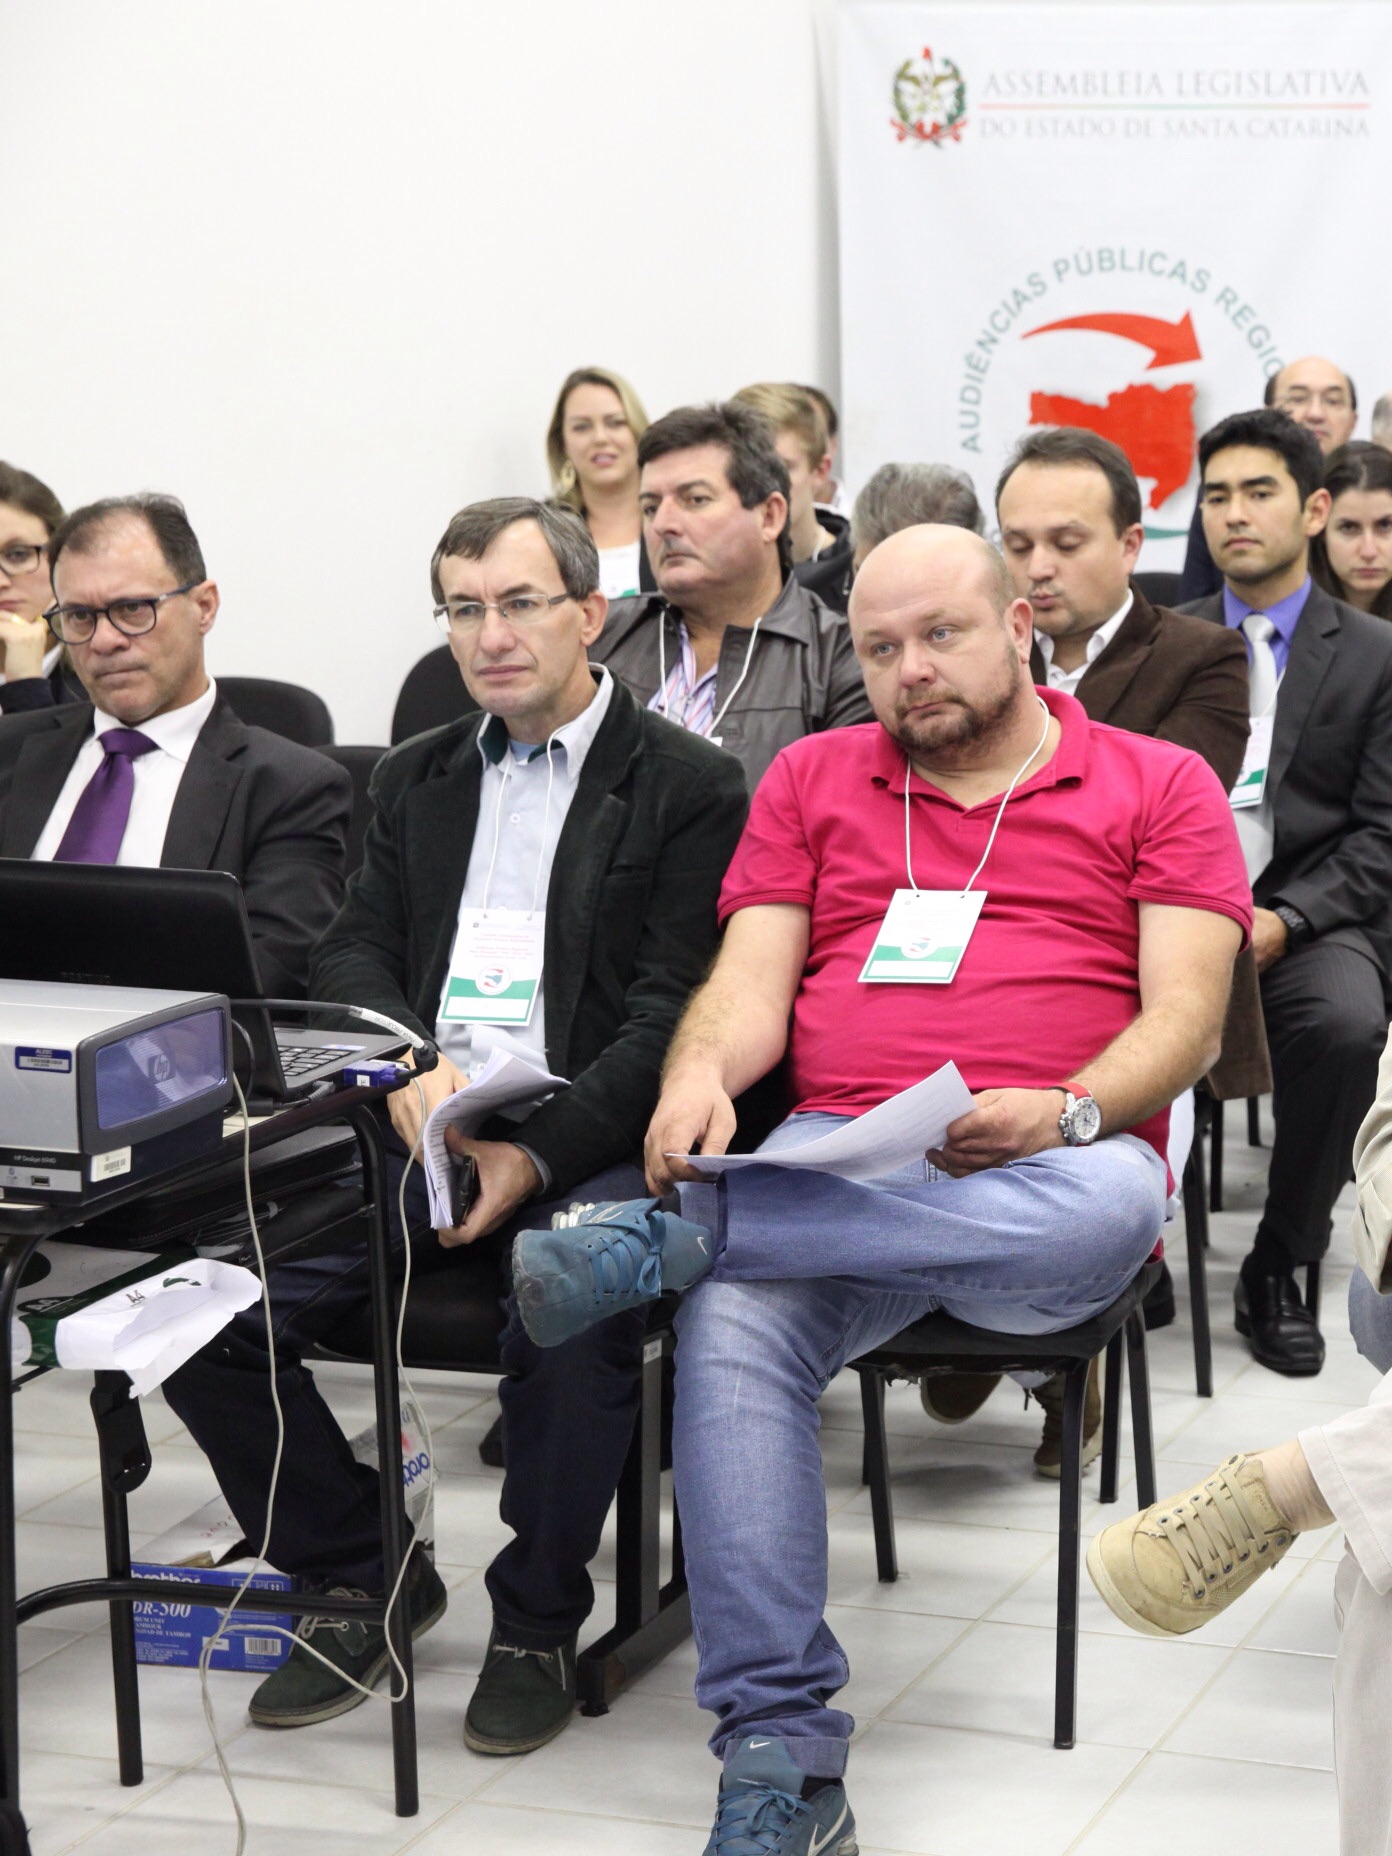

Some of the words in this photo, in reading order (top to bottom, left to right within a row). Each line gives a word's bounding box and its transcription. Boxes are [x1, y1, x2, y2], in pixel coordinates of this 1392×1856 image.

[983, 69, 1165, 97] ASSEMBLEIA
[1175, 69, 1370, 97] LEGISLATIVA
[979, 116, 1018, 139] DO
[1025, 116, 1116, 139] ESTADO
[1124, 116, 1154, 139] DE
[1162, 116, 1240, 139] SANTA
[1246, 116, 1370, 140] CATARINA
[958, 271, 1048, 455] AUDIÊNCIAS
[1053, 246, 1212, 295] PÚBLICAS
[1214, 286, 1285, 379] REGIO
[126, 1289, 146, 1304] A4
